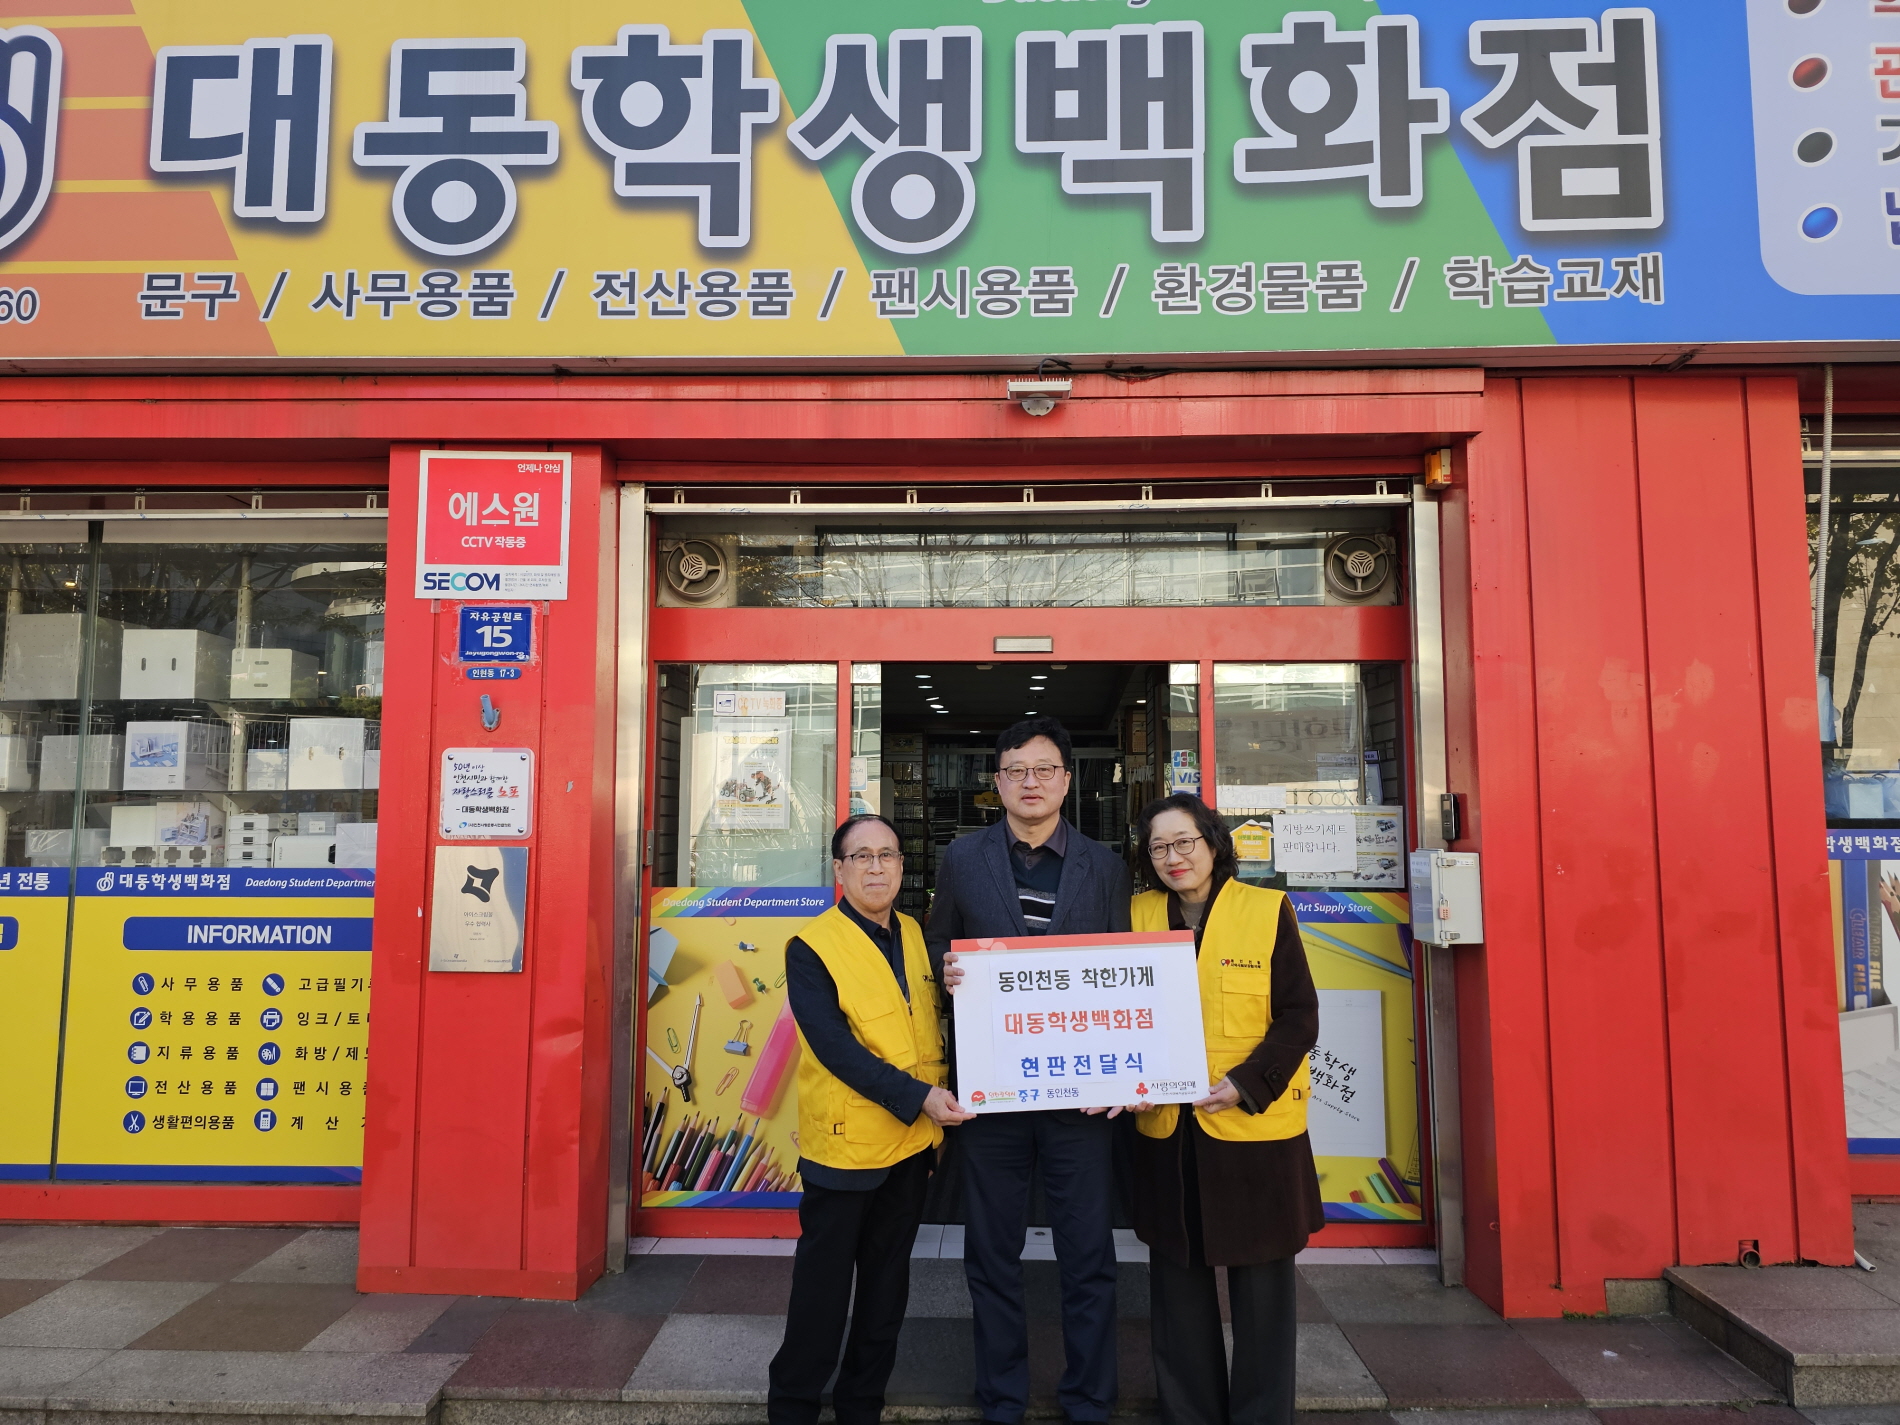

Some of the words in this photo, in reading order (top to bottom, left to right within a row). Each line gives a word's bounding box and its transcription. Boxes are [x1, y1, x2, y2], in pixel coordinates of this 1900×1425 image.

[154, 13, 1660, 250] 대동학생백화점
[139, 272, 238, 318] 문구
[311, 271, 515, 318] 사무용품
[592, 270, 794, 318] 전산용품
[871, 266, 1076, 318] 팬시용품
[1153, 262, 1365, 313] 환경물품
[1445, 254, 1663, 307] 학습교재
[517, 463, 542, 473] 언제나
[544, 463, 560, 473] 안심
[449, 492, 540, 527] 에스원
[461, 536, 493, 548] CCTV
[494, 536, 526, 548] 작동중
[423, 572, 501, 592] SECOM
[469, 612, 523, 623] 자유공원로
[475, 625, 513, 648] 15
[472, 668, 495, 678] 인현동
[763, 697, 783, 710] 녹화중
[453, 762, 471, 772] 50년
[471, 764, 485, 773] 이상
[453, 774, 488, 784] 인천시민과
[452, 786, 494, 799] 자랑스러운
[497, 786, 520, 798] 노포
[461, 805, 510, 814] 대동학생백화점
[1282, 823, 1348, 836] 지방쓰기세트
[1282, 842, 1341, 854] 판매합니다.
[17, 872, 51, 891] 전통
[119, 872, 231, 891] 대동학생백화점
[245, 877, 288, 889] Daedong
[289, 877, 325, 888] Student
[662, 897, 705, 909] Daedong
[706, 897, 742, 907] Student
[743, 897, 799, 909] Department
[800, 897, 825, 907] Store
[1297, 902, 1313, 912] Art
[1314, 902, 1347, 914] Supply
[1347, 902, 1373, 913] Store
[186, 924, 333, 945] INFORMATION
[998, 968, 1071, 993] 동인천동
[1081, 965, 1155, 989] 착한가게
[1852, 963, 1867, 993] FILE
[1870, 961, 1881, 990] FILE
[160, 977, 245, 992] 사무용품
[1004, 1007, 1154, 1035] 대동학생백화점
[1020, 1052, 1144, 1078] 현판전달식
[1150, 1080, 1197, 1093] 사랑의열매
[1018, 1089, 1041, 1103] 중구
[1046, 1087, 1080, 1099] 동인천동
[1323, 1099, 1344, 1115] Supply
[1344, 1110, 1361, 1123] Store
[152, 1115, 235, 1130] 생활편의용품
